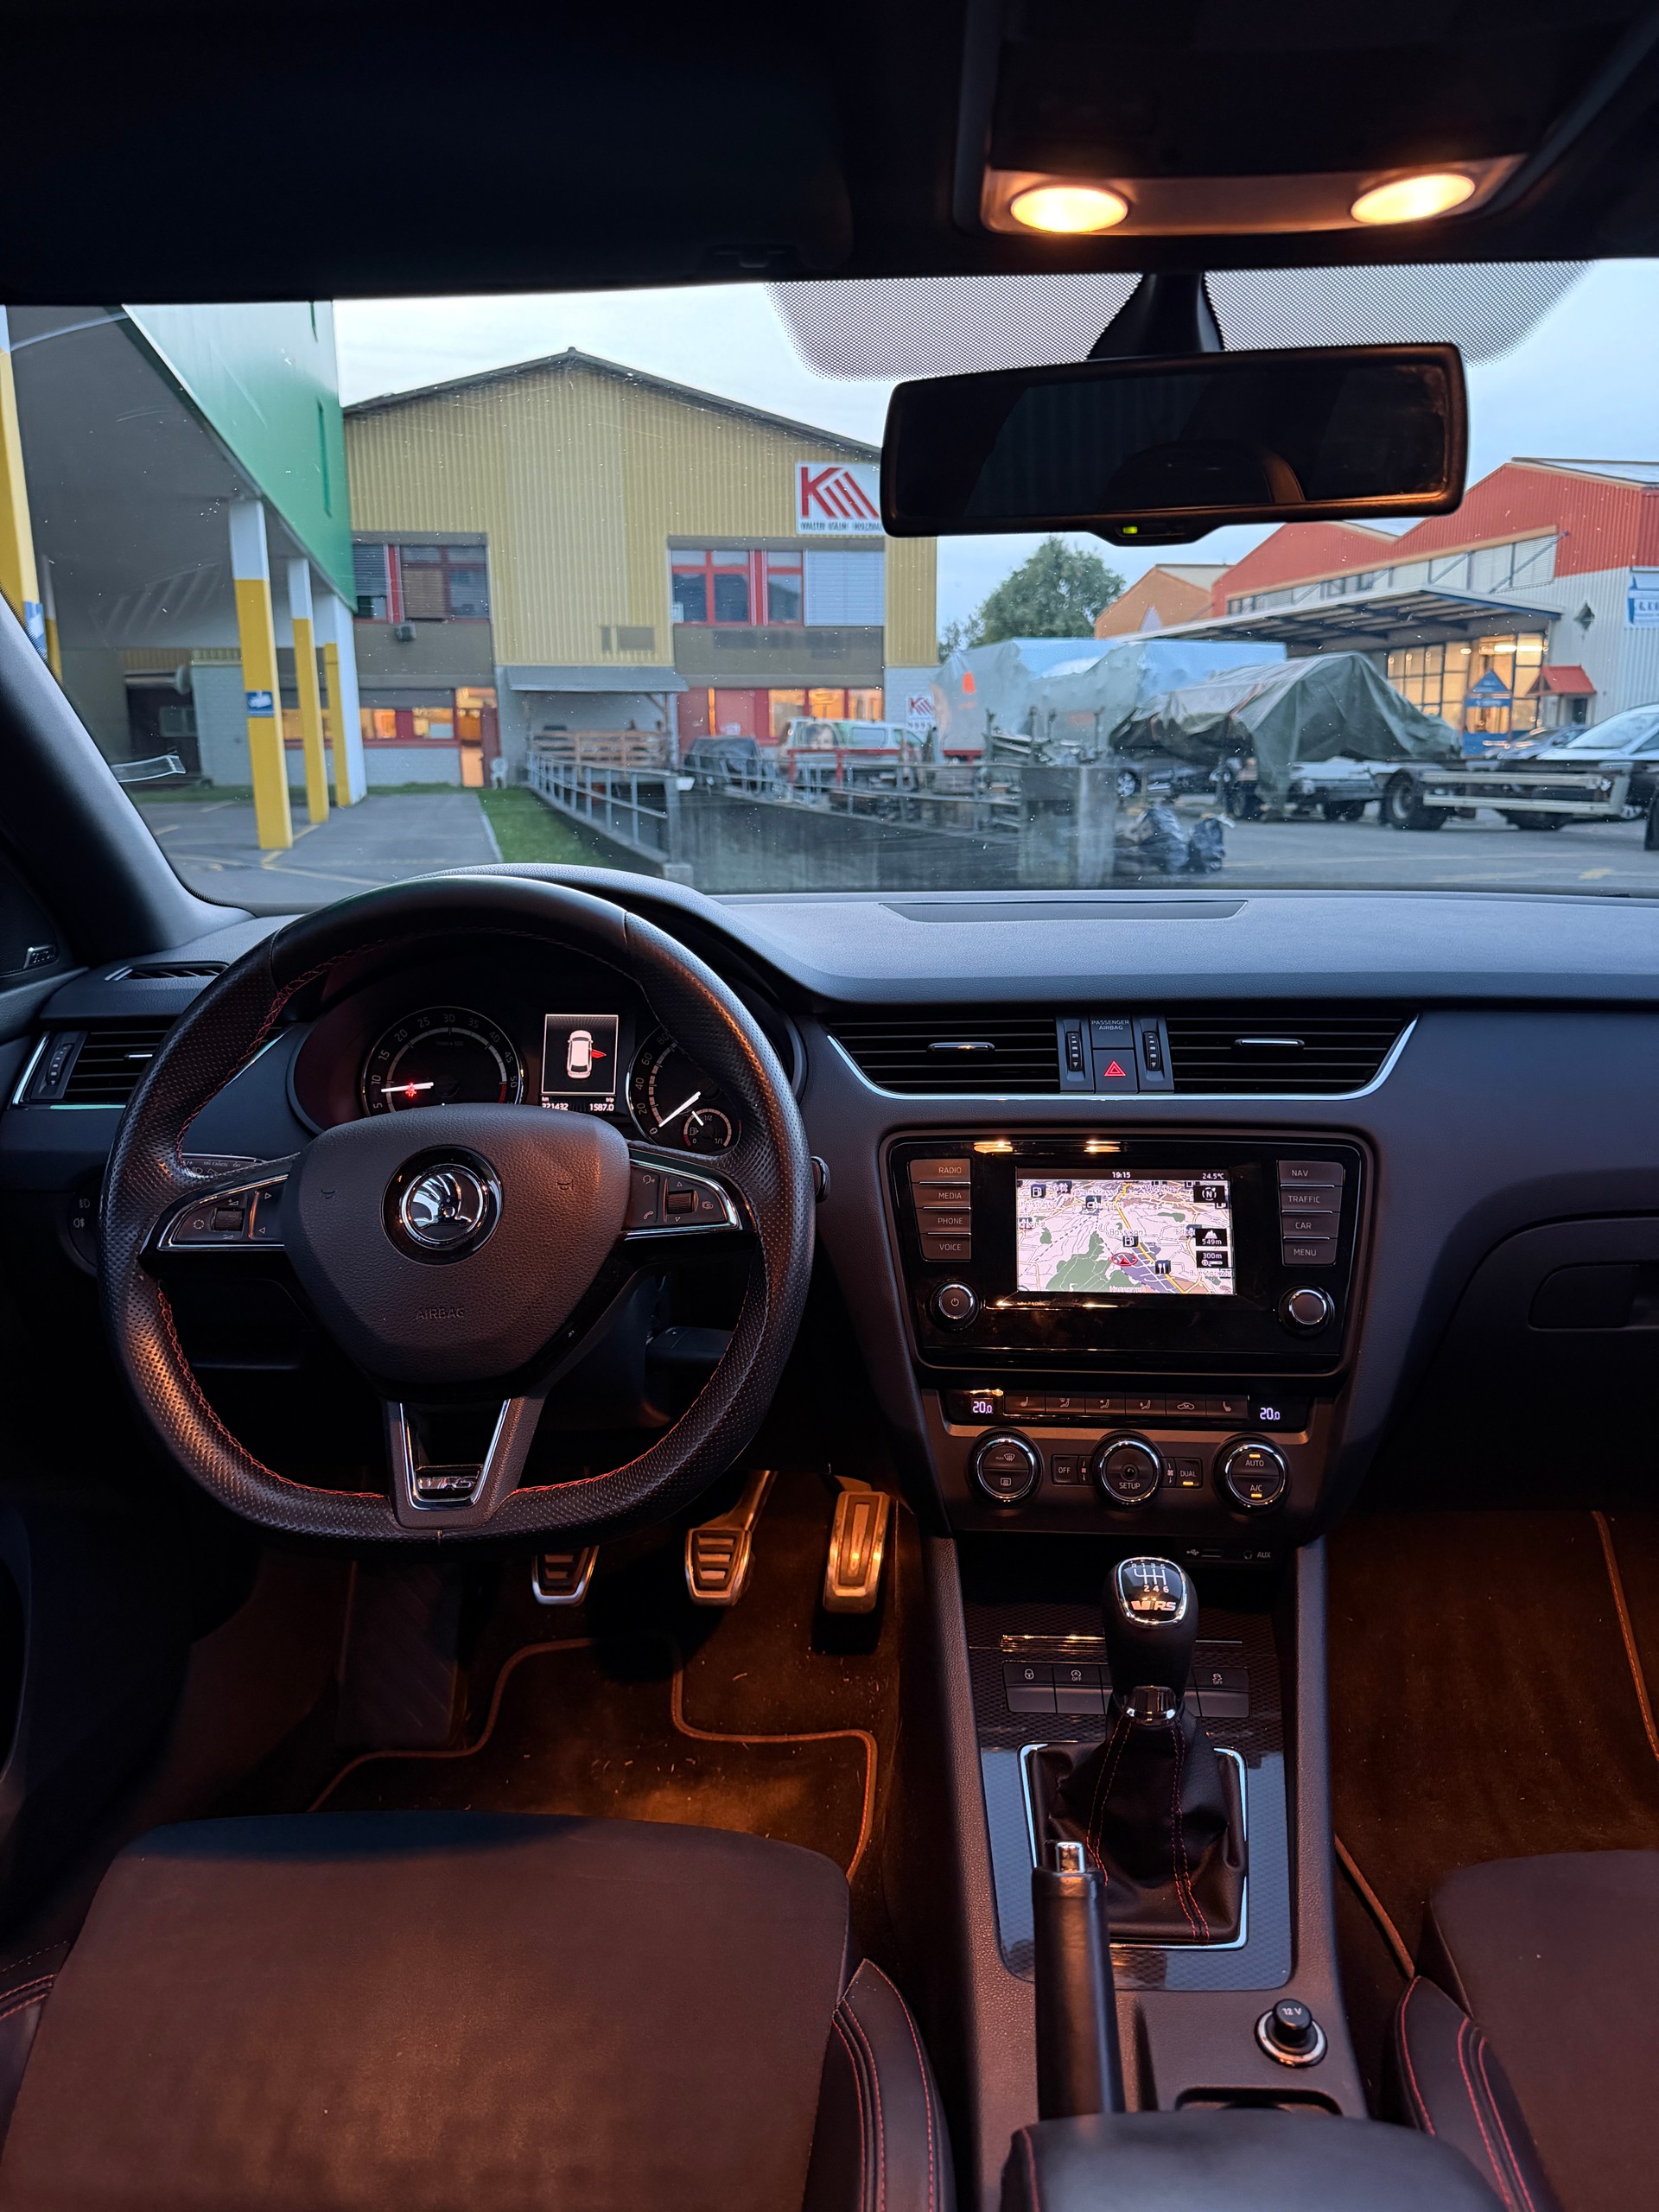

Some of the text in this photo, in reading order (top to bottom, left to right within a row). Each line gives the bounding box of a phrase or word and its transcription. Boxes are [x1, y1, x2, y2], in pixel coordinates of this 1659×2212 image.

[416, 1016, 431, 1028] 25
[443, 1014, 455, 1023] 30
[467, 1017, 480, 1029] 35
[394, 1028, 409, 1042] 20
[489, 1031, 501, 1043] 40
[378, 1049, 391, 1061] 15
[505, 1051, 514, 1064] 45
[641, 1052, 653, 1065] 60
[372, 1074, 382, 1085] 10
[510, 1075, 518, 1088] 50
[635, 1077, 645, 1090] 40
[589, 1103, 614, 1112] 1587.0
[637, 1103, 648, 1115] 20
[649, 1127, 658, 1135] 0
[1288, 1195, 1321, 1204] TRAFFIC
[416, 1307, 465, 1320] AIRBAG
[1282, 2007, 1294, 2016] 12
